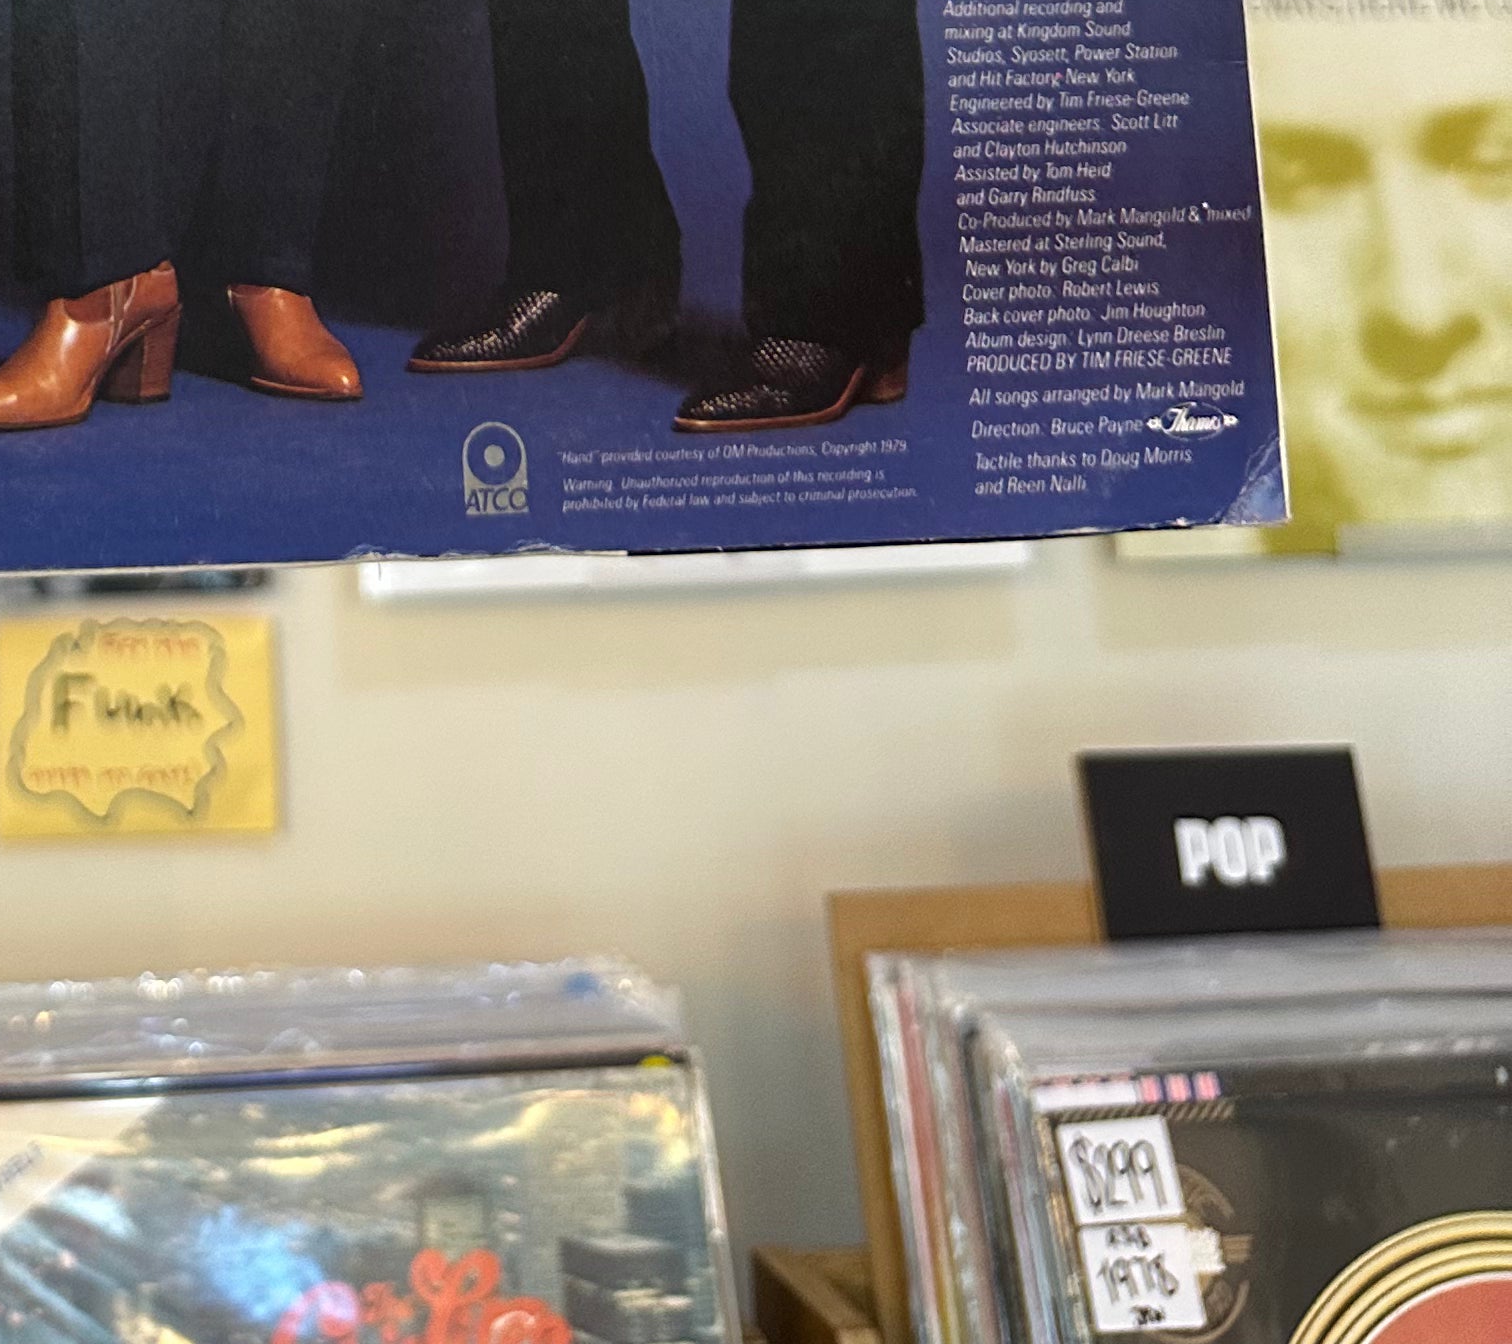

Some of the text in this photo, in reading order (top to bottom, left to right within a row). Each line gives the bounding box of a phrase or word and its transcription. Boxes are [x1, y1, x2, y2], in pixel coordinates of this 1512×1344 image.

[944, 1, 1019, 17] Additional
[1023, 0, 1092, 19] recording
[945, 21, 1130, 42] mixing at Kingdom Sound
[950, 94, 1032, 113] Engineered
[1036, 93, 1054, 112] by
[1059, 92, 1084, 108] Tim
[954, 140, 1126, 160] and Clayton Hutchinson
[955, 164, 1018, 181] Assisted
[1022, 164, 1040, 182] by
[1046, 164, 1073, 179] Tom
[957, 188, 1096, 208] and Garry Rindfuss
[959, 236, 1030, 253] Mastered
[1036, 236, 1051, 250] at
[1055, 233, 1112, 253] Sterling
[965, 255, 1140, 277] New York by Greg Calbi
[963, 284, 1004, 302] Cover
[1062, 281, 1112, 297] Robert
[1116, 280, 1159, 296] Lewis
[963, 307, 999, 325] Back
[1003, 308, 1043, 323] cover
[1101, 305, 1129, 321] Jim
[1134, 303, 1205, 321] Houghton
[967, 347, 1232, 372] PRODUCED BY TIM FRIESE-GREENE
[969, 380, 1244, 407] All songs arranged by Mark Mangold
[1051, 418, 1094, 435] Bruce
[1098, 416, 1143, 436] Payne
[975, 447, 1192, 471] Tactile thanks to Doug Morris
[465, 486, 528, 512] ATCO
[562, 497, 623, 513] prohibited
[739, 491, 780, 505] subject
[784, 490, 796, 502] to
[51, 671, 204, 733] Funk
[1173, 814, 1285, 887] POP
